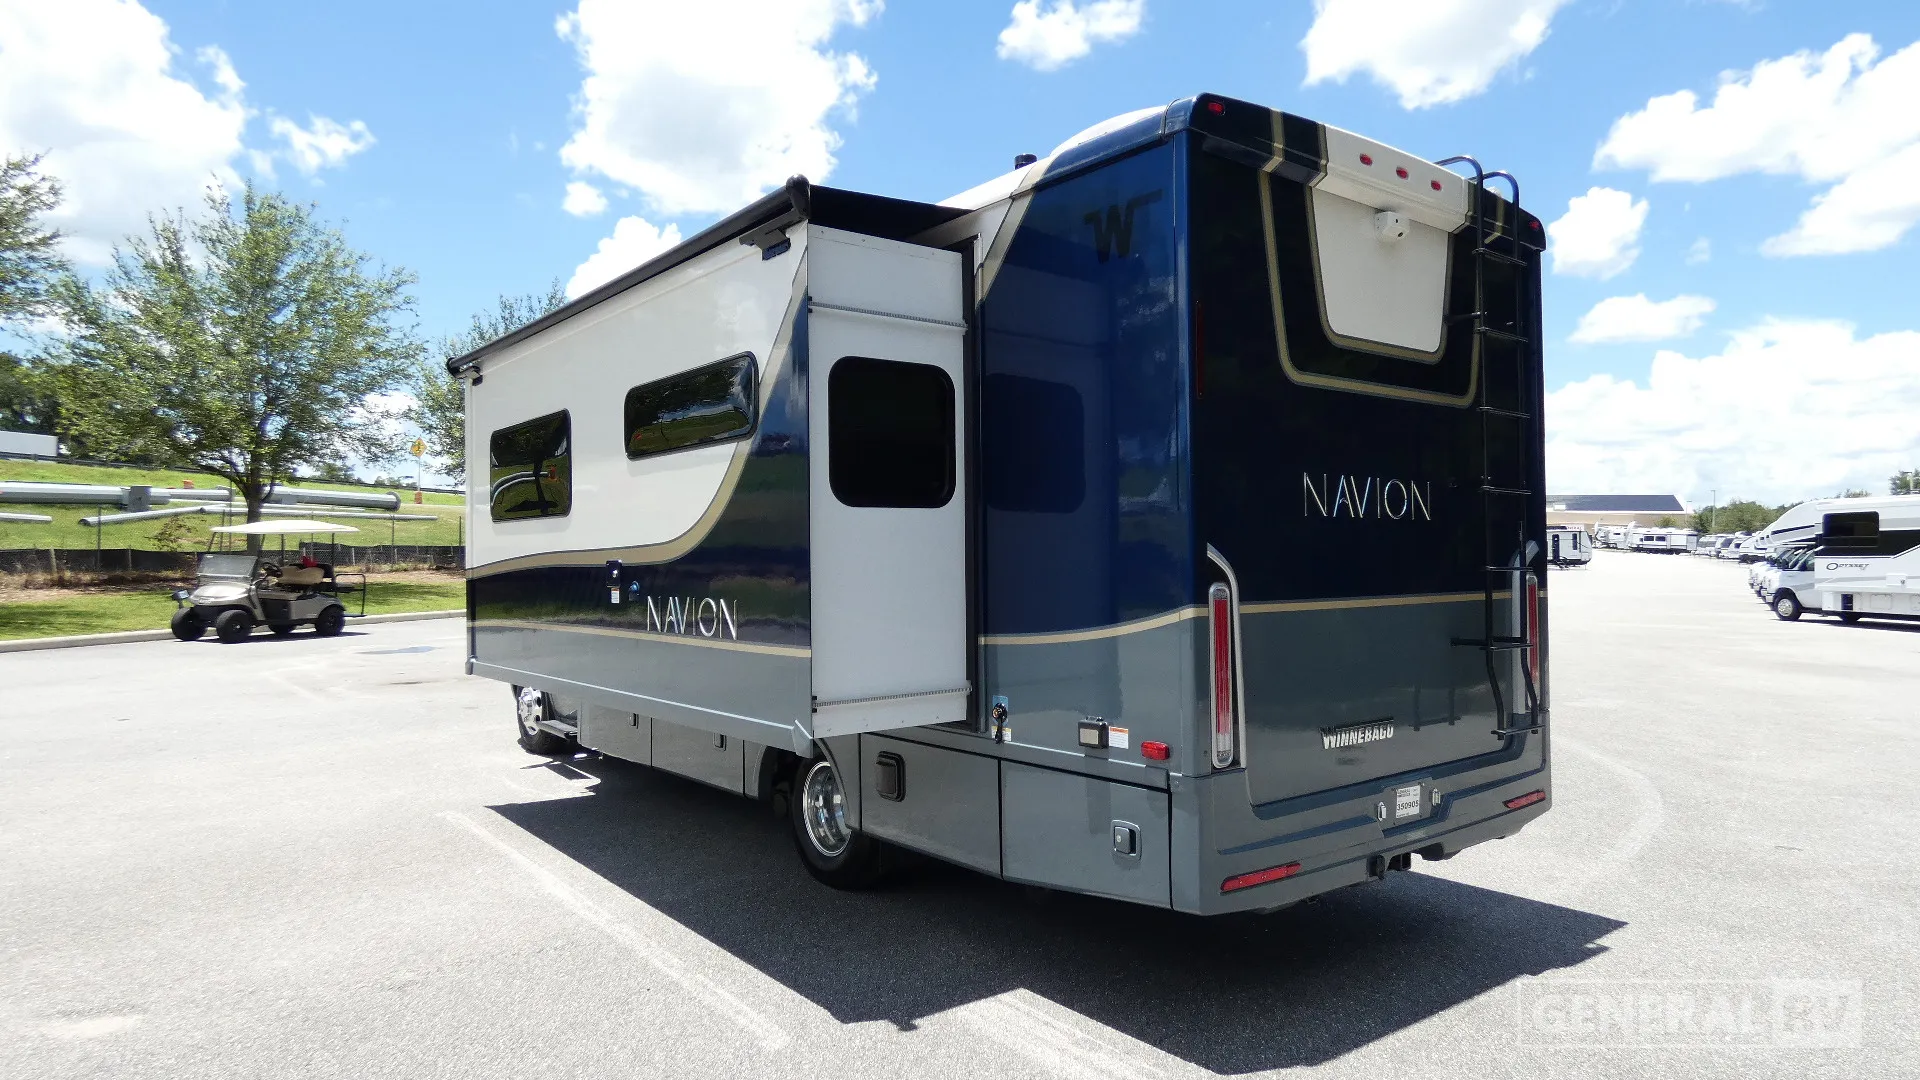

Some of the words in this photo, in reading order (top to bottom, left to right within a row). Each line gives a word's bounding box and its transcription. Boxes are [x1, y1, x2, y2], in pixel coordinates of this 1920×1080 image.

[1303, 472, 1431, 520] NAVION
[647, 595, 737, 640] NAVION
[1321, 721, 1394, 750] WINNEBAGO
[1396, 800, 1419, 811] 350905
